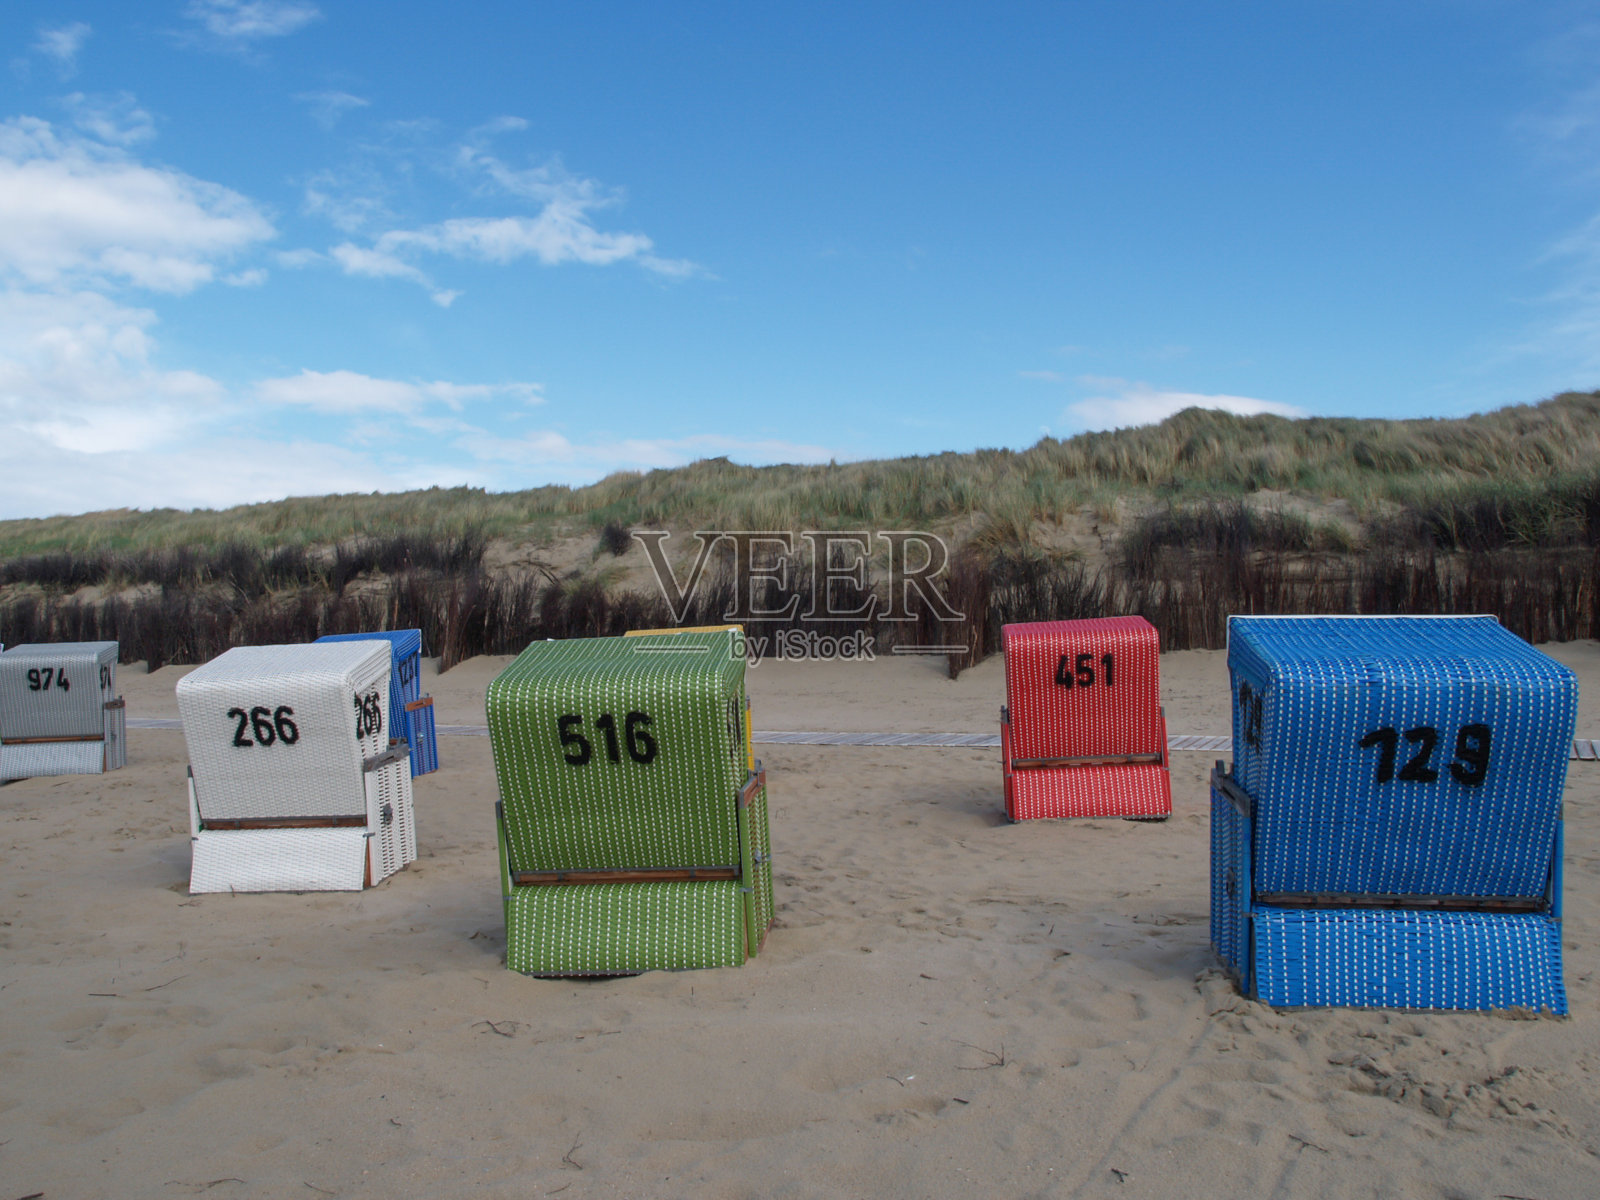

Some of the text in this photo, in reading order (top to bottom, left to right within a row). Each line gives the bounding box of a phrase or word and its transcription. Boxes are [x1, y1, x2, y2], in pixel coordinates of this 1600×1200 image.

[27, 667, 70, 692] 974
[1055, 652, 1114, 689] 451
[227, 706, 300, 747] 266
[353, 691, 382, 740] 266
[557, 711, 658, 766] 516
[1358, 723, 1491, 788] 129
